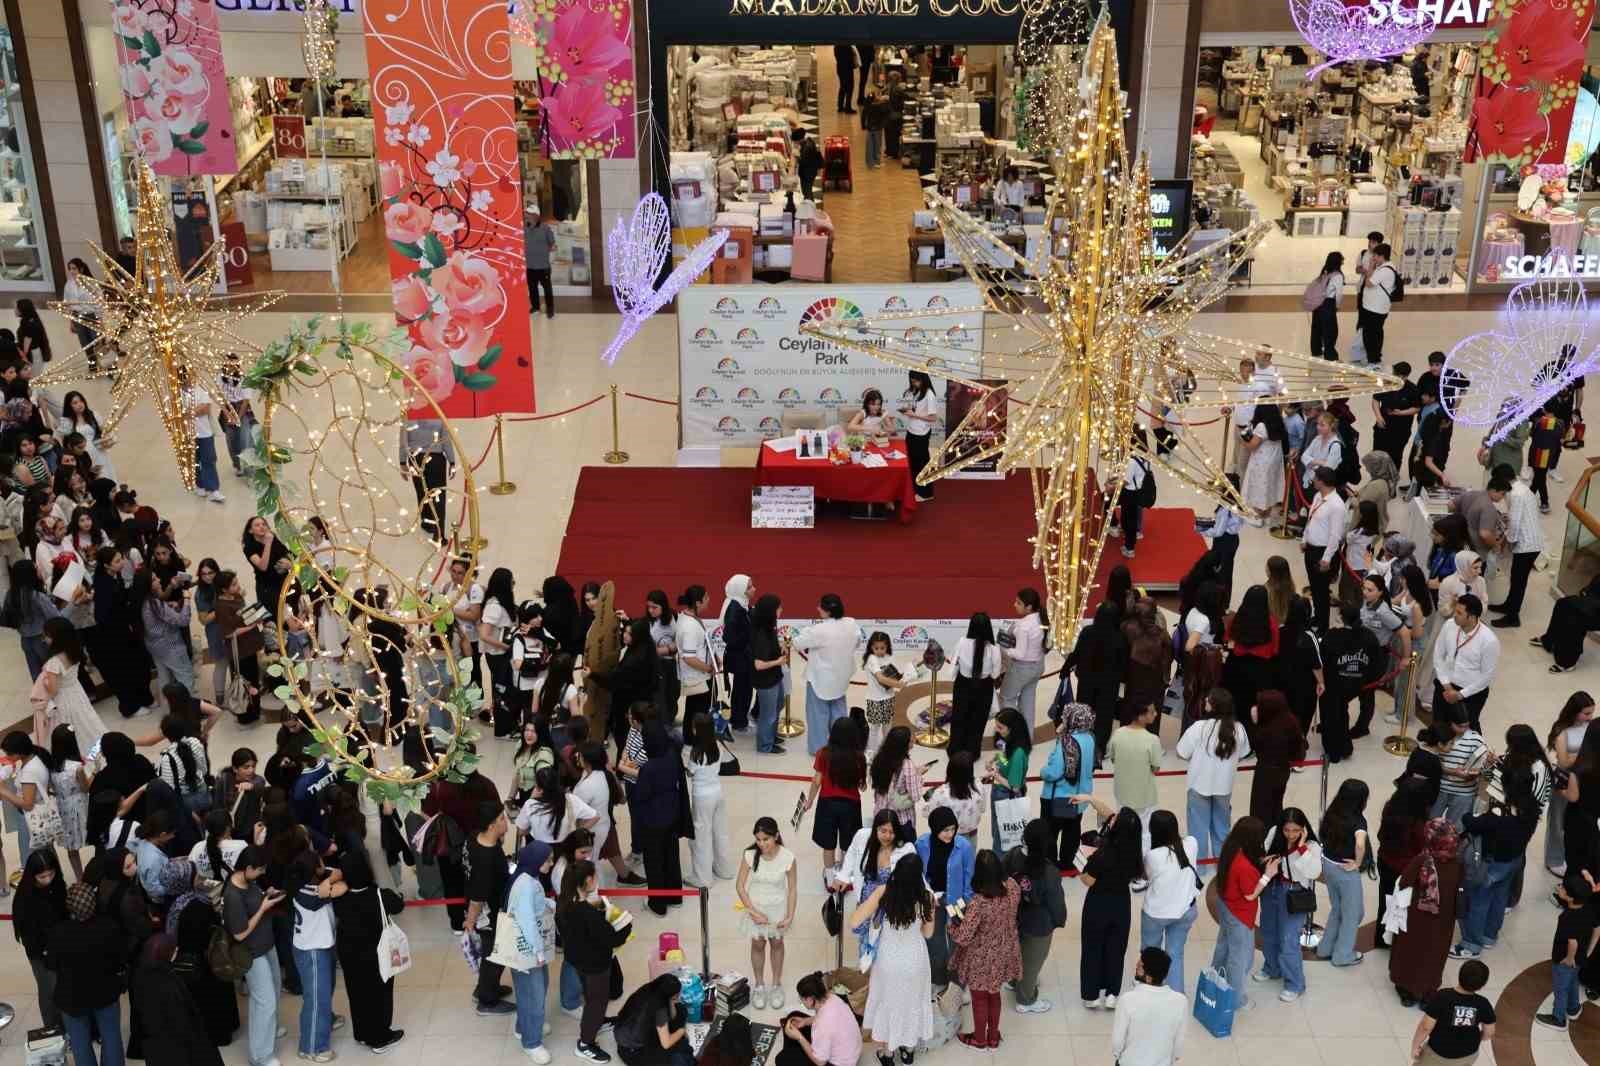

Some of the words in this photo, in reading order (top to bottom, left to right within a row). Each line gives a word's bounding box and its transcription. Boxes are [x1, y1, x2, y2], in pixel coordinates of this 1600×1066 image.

[729, 0, 919, 16] MADAME
[778, 336, 834, 353] Ceylan
[815, 352, 848, 365] Park
